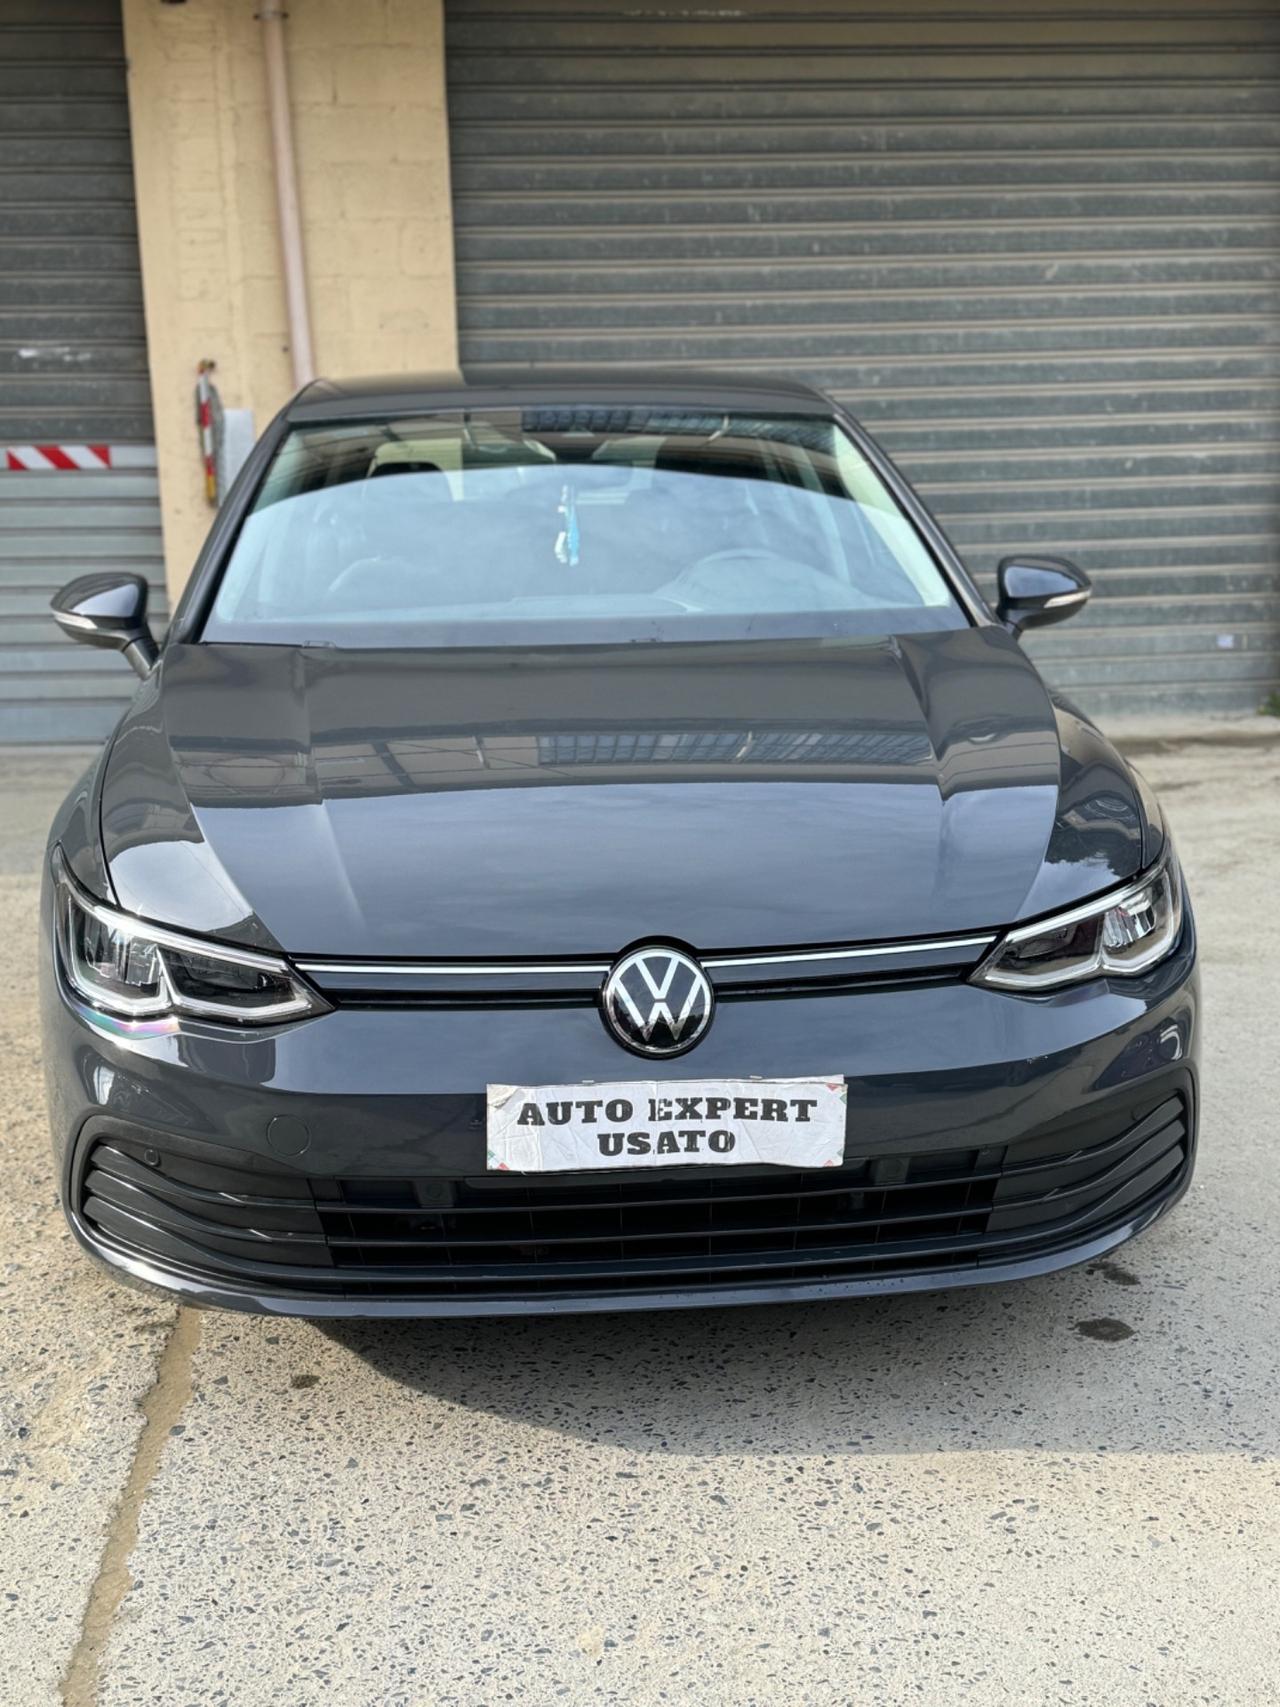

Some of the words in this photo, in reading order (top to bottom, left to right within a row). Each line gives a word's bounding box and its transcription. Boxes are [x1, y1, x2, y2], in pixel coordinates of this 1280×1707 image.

[517, 1098, 633, 1126] AUTO
[648, 1096, 817, 1122] EXPERT
[597, 1130, 735, 1156] USATO
